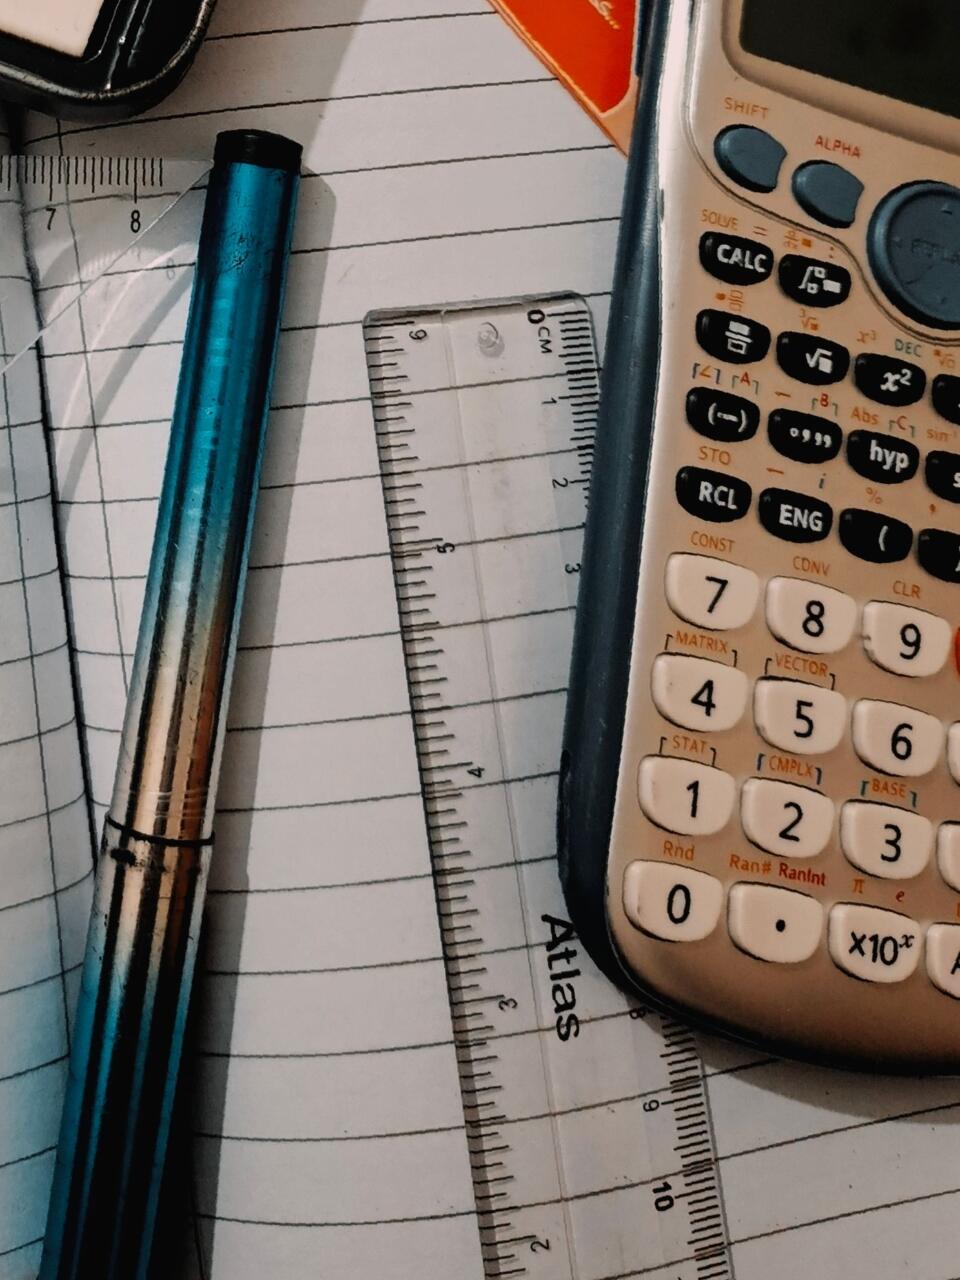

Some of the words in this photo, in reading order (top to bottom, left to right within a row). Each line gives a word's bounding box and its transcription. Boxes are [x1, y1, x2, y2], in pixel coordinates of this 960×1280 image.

[724, 97, 768, 120] SHIFT
[815, 135, 862, 159] ALPHA
[45, 209, 57, 231] 7
[130, 211, 142, 233] 8
[701, 208, 738, 231] SOLVE
[716, 243, 767, 273] CALC
[538, 327, 553, 354] CM
[895, 339, 922, 358] DEC
[850, 406, 880, 426] Abs
[698, 446, 731, 466] STO
[869, 439, 910, 473] hyp
[698, 480, 738, 510] RCL
[779, 504, 823, 532] ENG
[691, 531, 735, 553] CONST
[793, 556, 830, 577] CONV
[705, 576, 728, 613] 7
[892, 580, 921, 598] CLR
[802, 600, 825, 637] 8
[676, 631, 729, 654] MATRIX
[899, 623, 921, 660] 9
[775, 653, 828, 676] VECTOR
[690, 680, 715, 717] 4
[793, 700, 814, 738] 5
[672, 735, 706, 754] STAT
[891, 723, 913, 759] 6
[768, 755, 813, 778] CMPLX
[686, 780, 700, 818] 1
[871, 778, 906, 799] BASE
[779, 801, 804, 842] 2
[663, 840, 695, 861] Rnd
[880, 823, 902, 862] 3
[729, 853, 771, 876] Ran#
[779, 862, 826, 886] RanInt
[667, 883, 691, 924] 0
[540, 913, 581, 1042] Atlas
[643, 1099, 660, 1113] 9
[652, 1181, 675, 1212] 10
